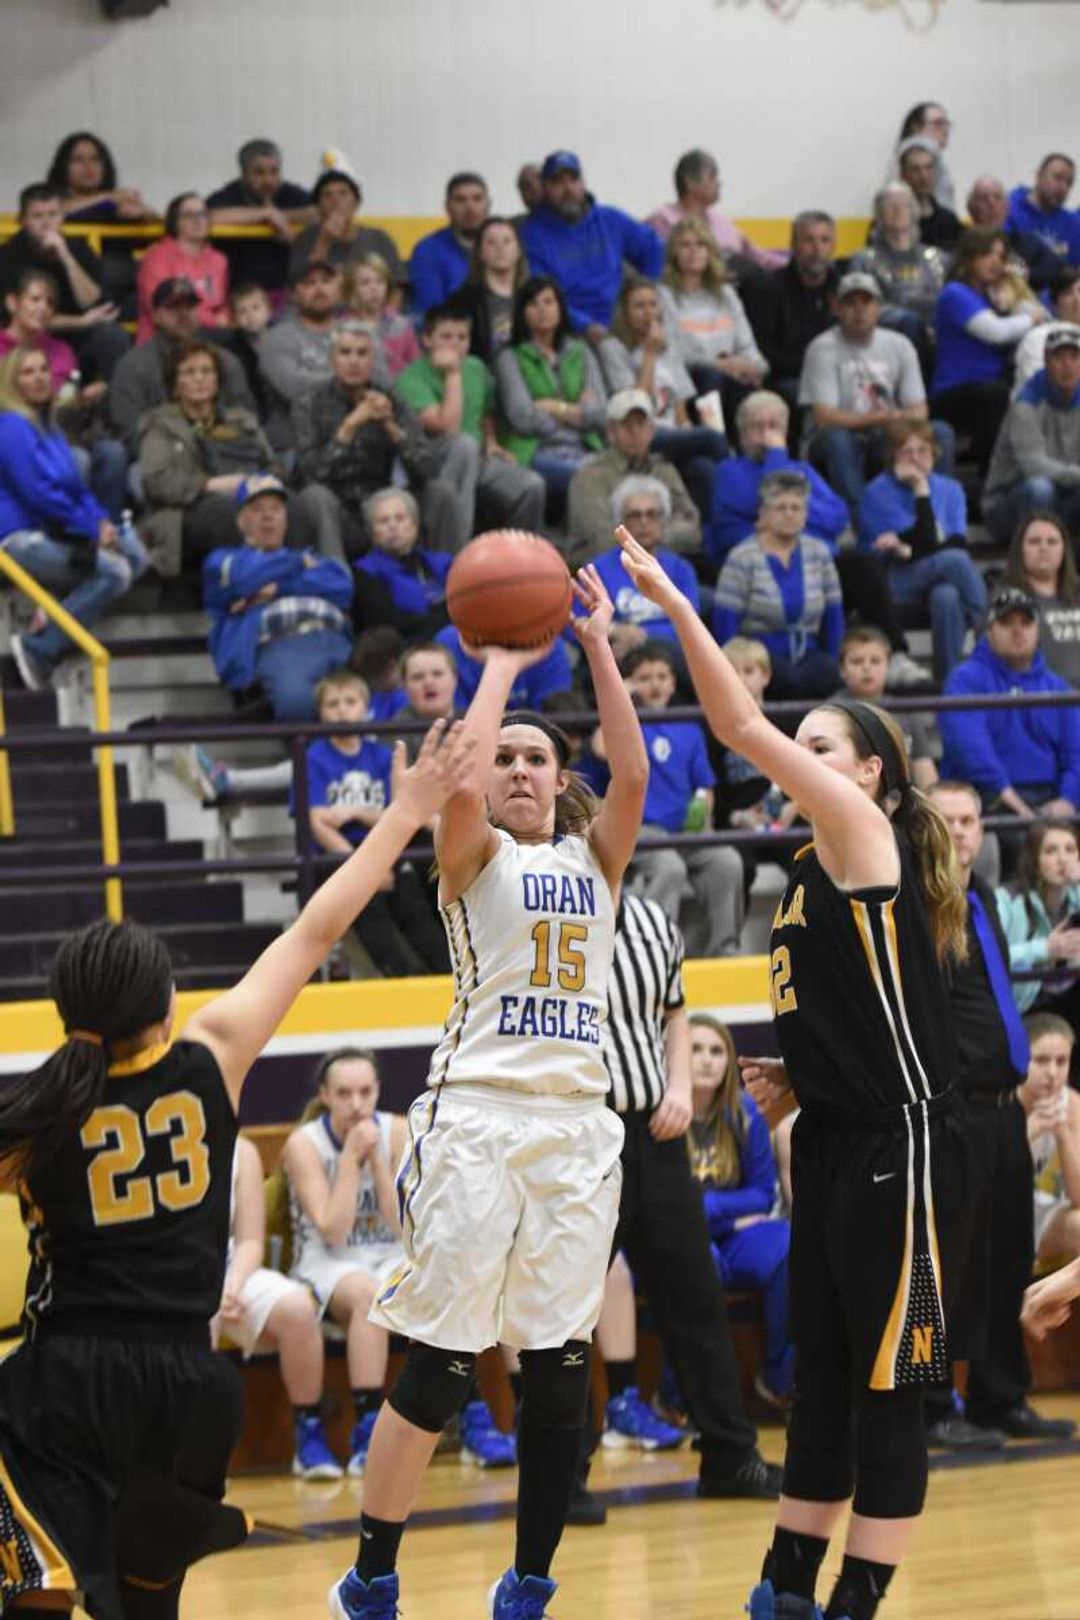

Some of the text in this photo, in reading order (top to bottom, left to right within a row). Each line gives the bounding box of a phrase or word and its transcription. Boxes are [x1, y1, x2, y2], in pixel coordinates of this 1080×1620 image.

[522, 873, 596, 917] ORAN
[530, 920, 588, 992] 15
[769, 945, 798, 1017] 2
[497, 995, 600, 1045] EAGLES
[80, 1089, 211, 1227] 23
[911, 1326, 934, 1364] N
